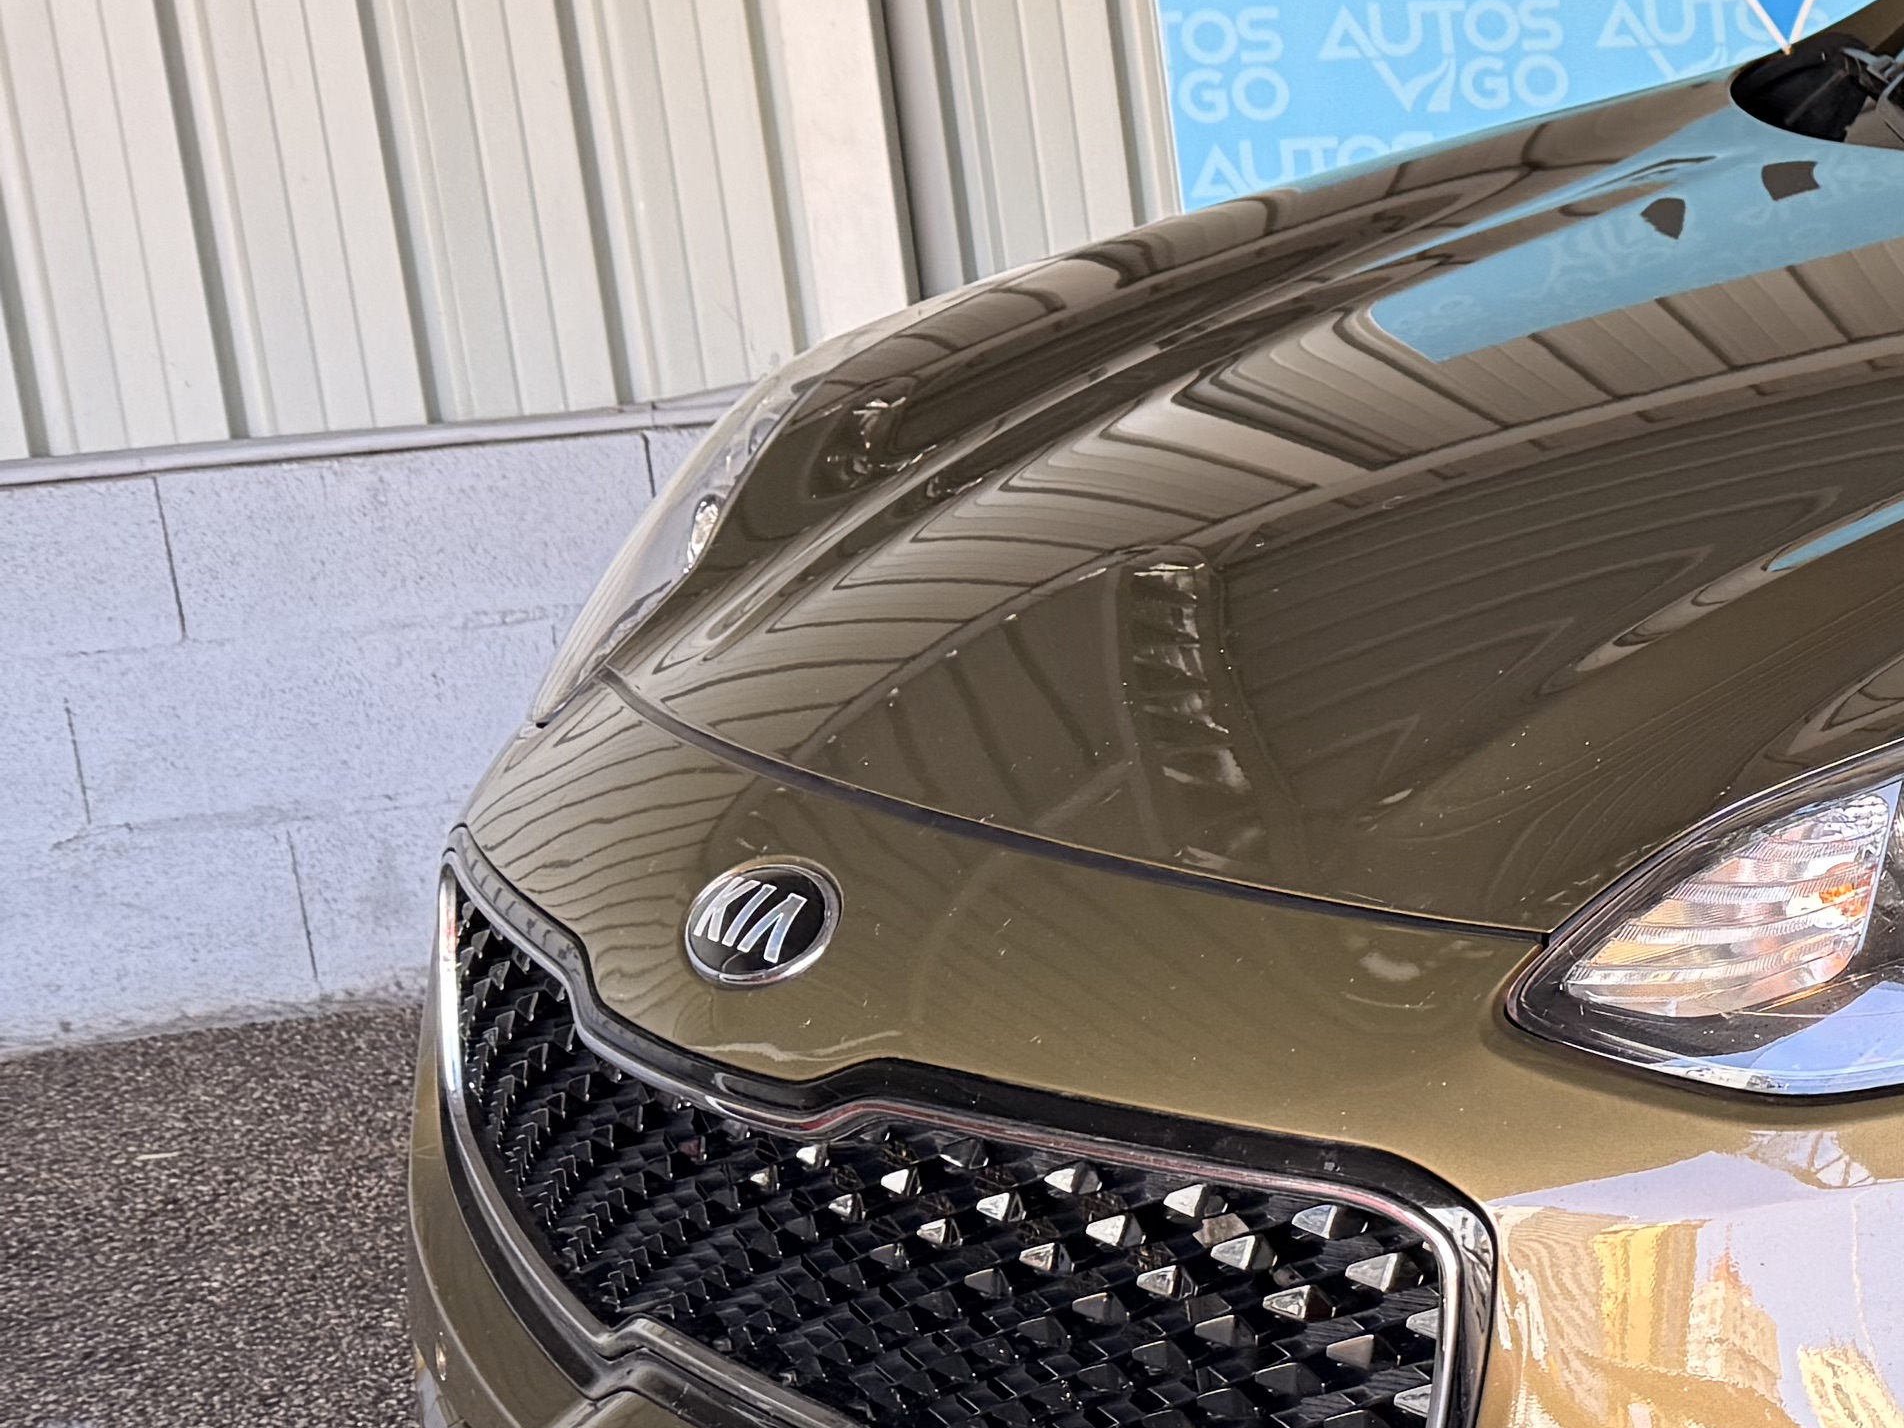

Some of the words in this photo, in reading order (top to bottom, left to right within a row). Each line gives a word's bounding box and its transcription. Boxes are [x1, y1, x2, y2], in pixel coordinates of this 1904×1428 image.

[1176, 66, 1289, 123] GO
[1375, 54, 1569, 113] VIGO
[693, 876, 808, 963] KIA
